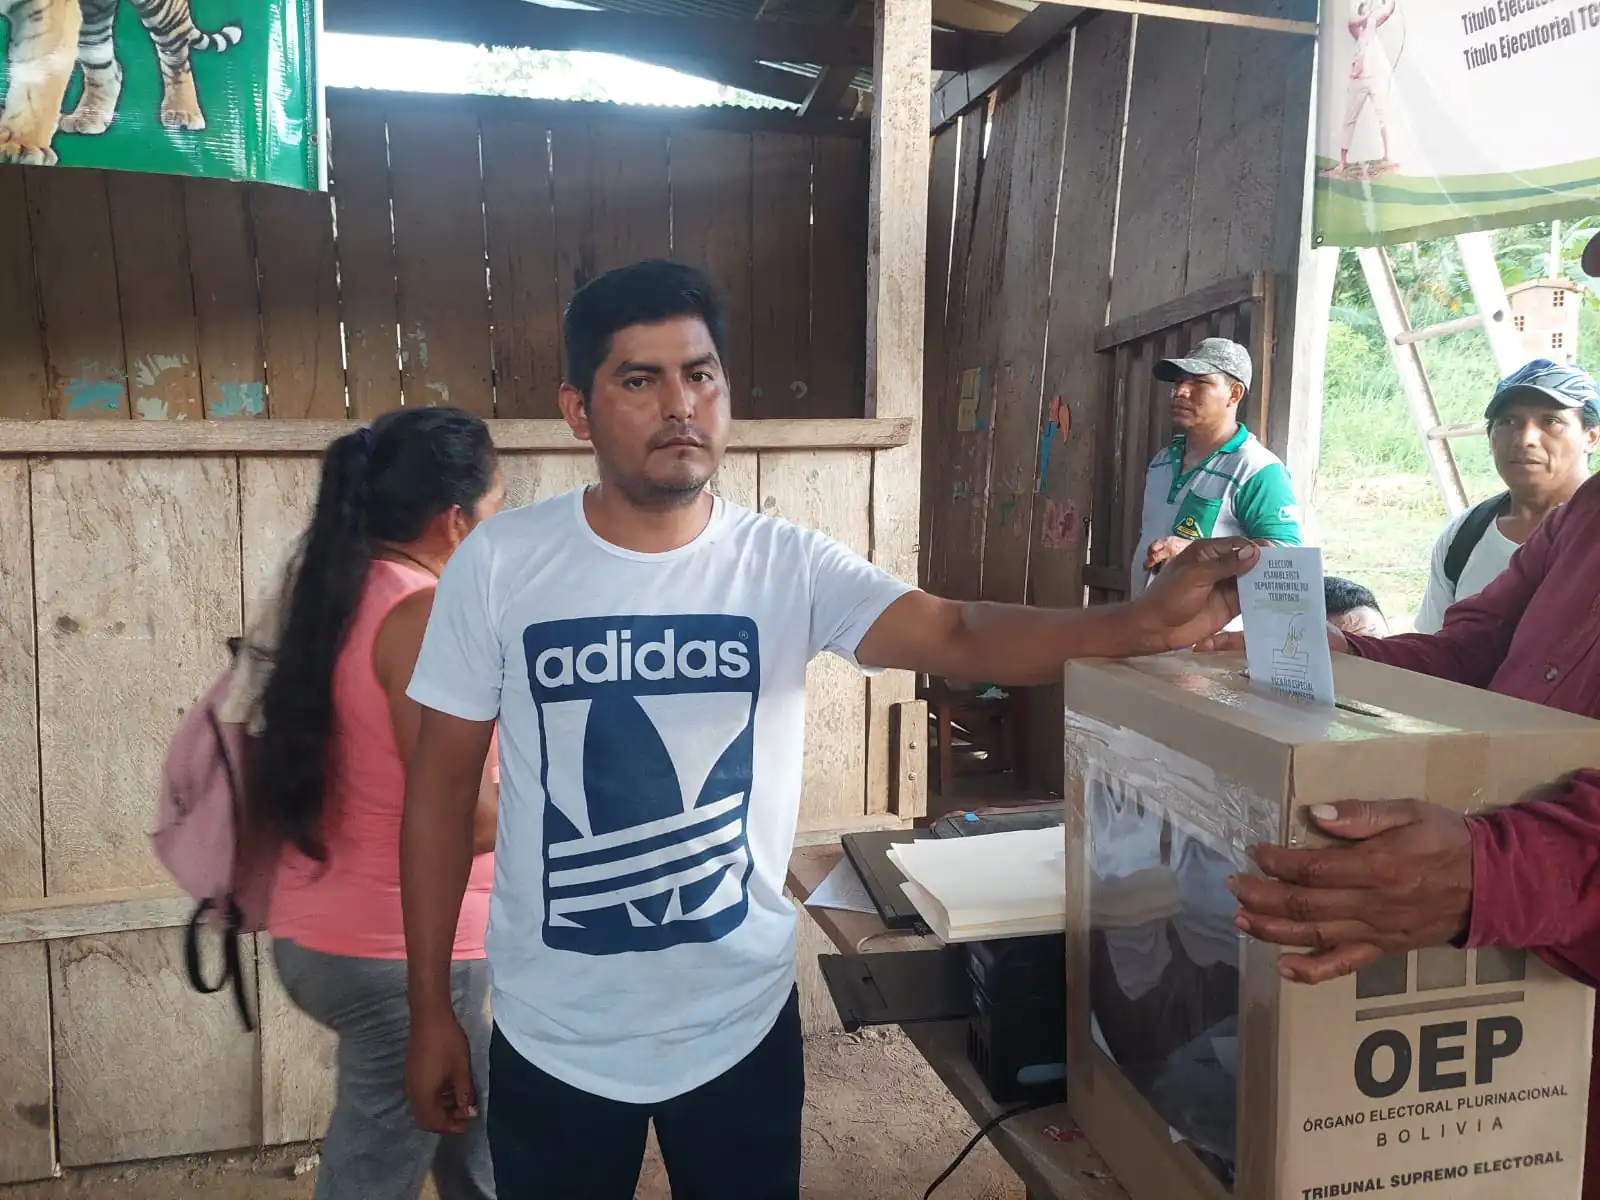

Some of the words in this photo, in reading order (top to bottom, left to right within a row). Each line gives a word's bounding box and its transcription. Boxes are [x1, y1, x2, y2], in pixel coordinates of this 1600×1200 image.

[1461, 6, 1497, 36] Título
[1463, 42, 1498, 71] Título
[1499, 10, 1576, 59] Ejecutorial
[1578, 1, 1600, 31] TC
[535, 628, 751, 688] adidas
[1354, 1015, 1523, 1098] OEP
[1303, 1111, 1365, 1132] ÓRGANO
[1370, 1100, 1453, 1123] ELECTORAL
[1457, 1083, 1568, 1110] PLURINACIONAL
[1376, 1116, 1503, 1147] BOLIVIA
[1301, 1177, 1385, 1200] TRIBUNAL
[1390, 1164, 1468, 1188] SUPREMO
[1473, 1150, 1564, 1176] ELECTORAL
